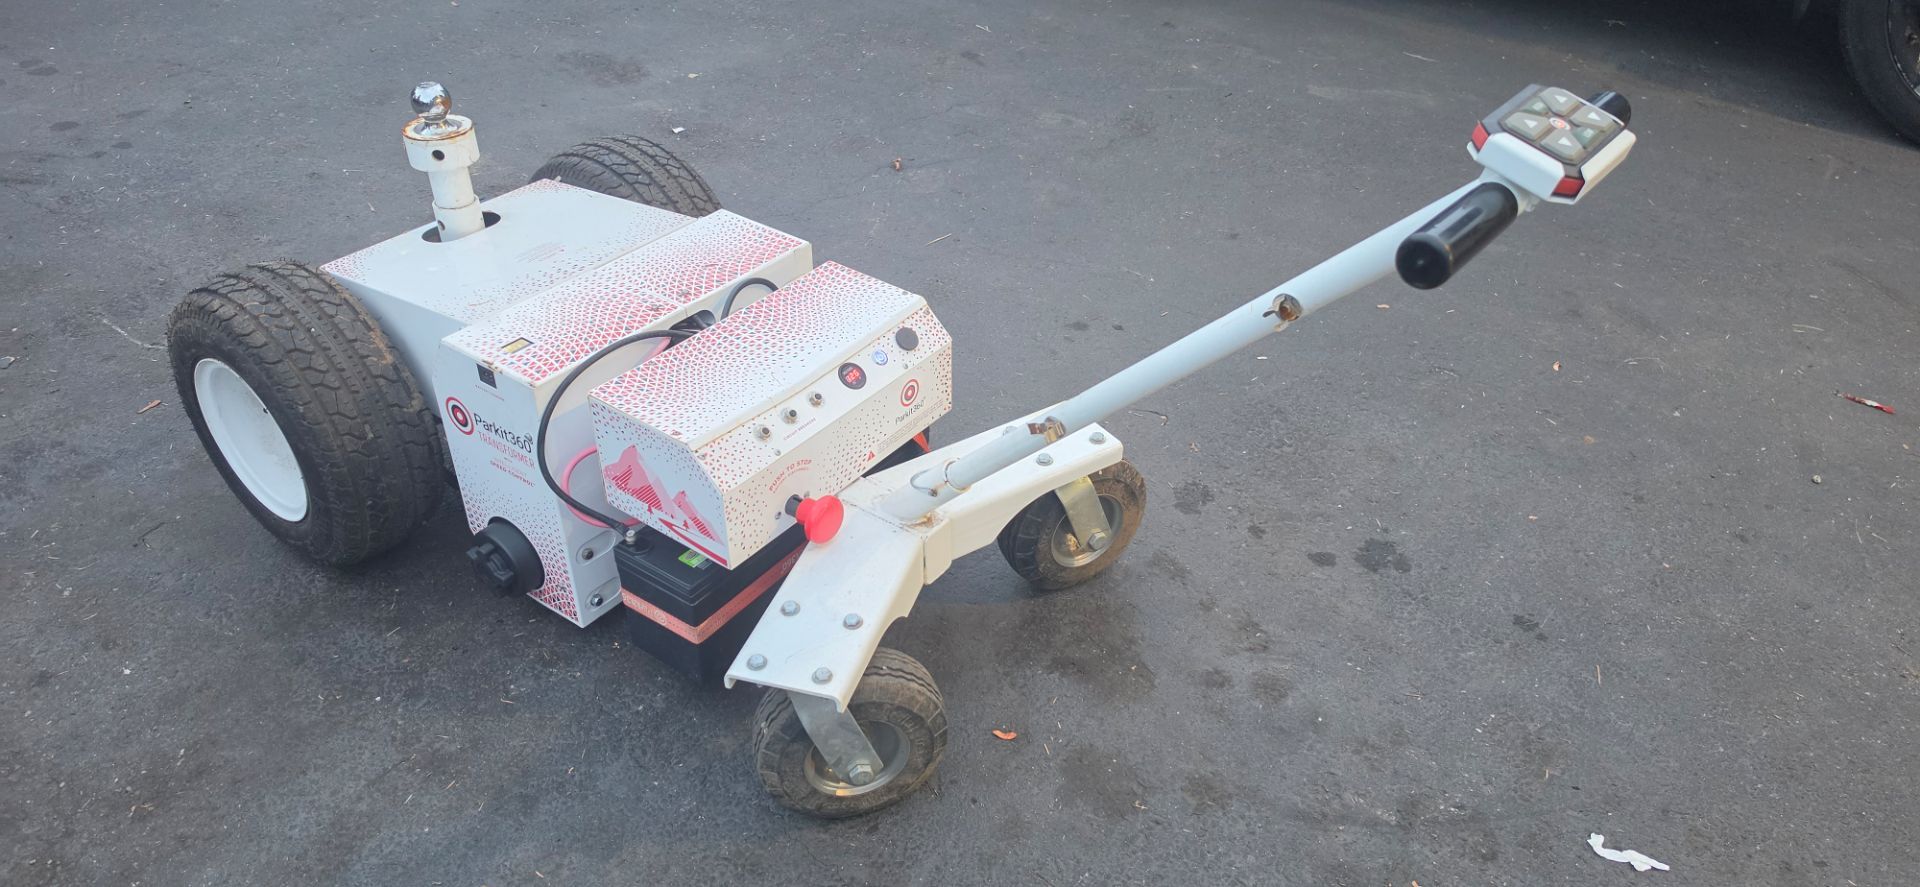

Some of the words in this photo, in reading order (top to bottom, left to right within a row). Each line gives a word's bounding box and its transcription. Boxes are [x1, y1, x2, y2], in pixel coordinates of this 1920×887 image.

[474, 412, 532, 453] Parkit360
[478, 431, 536, 470] TRANSFORMER
[768, 470, 785, 491] PUSH
[786, 463, 795, 472] TO
[796, 459, 812, 467] STOP
